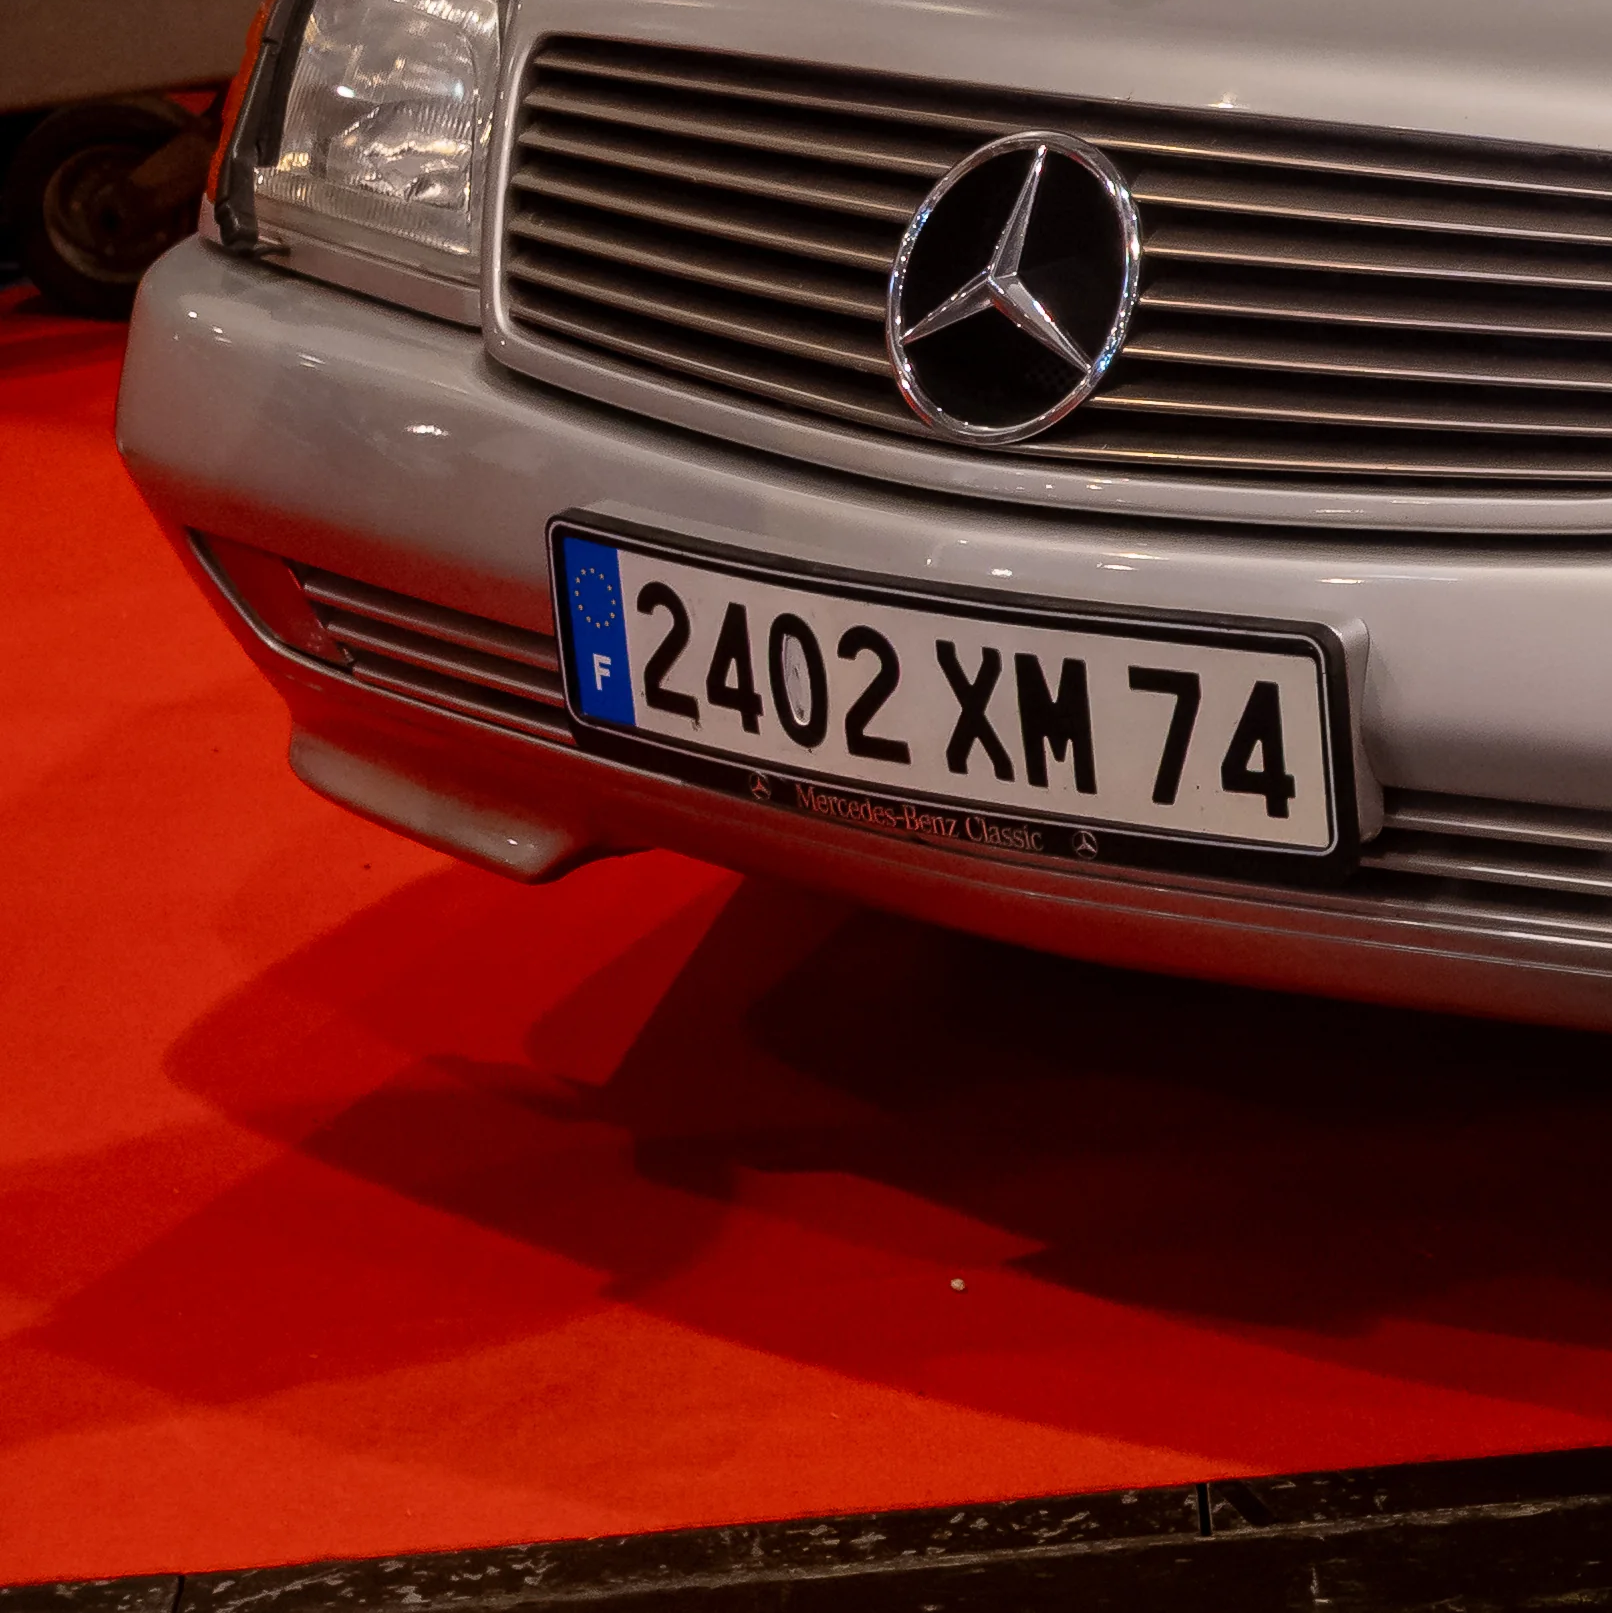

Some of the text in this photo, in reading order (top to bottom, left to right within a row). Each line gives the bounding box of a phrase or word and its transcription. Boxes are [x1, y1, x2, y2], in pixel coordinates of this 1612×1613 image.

[592, 653, 612, 691] F
[636, 580, 1296, 819] 2402 XM 74
[795, 784, 1045, 852] Mercedes-Benz Classic
